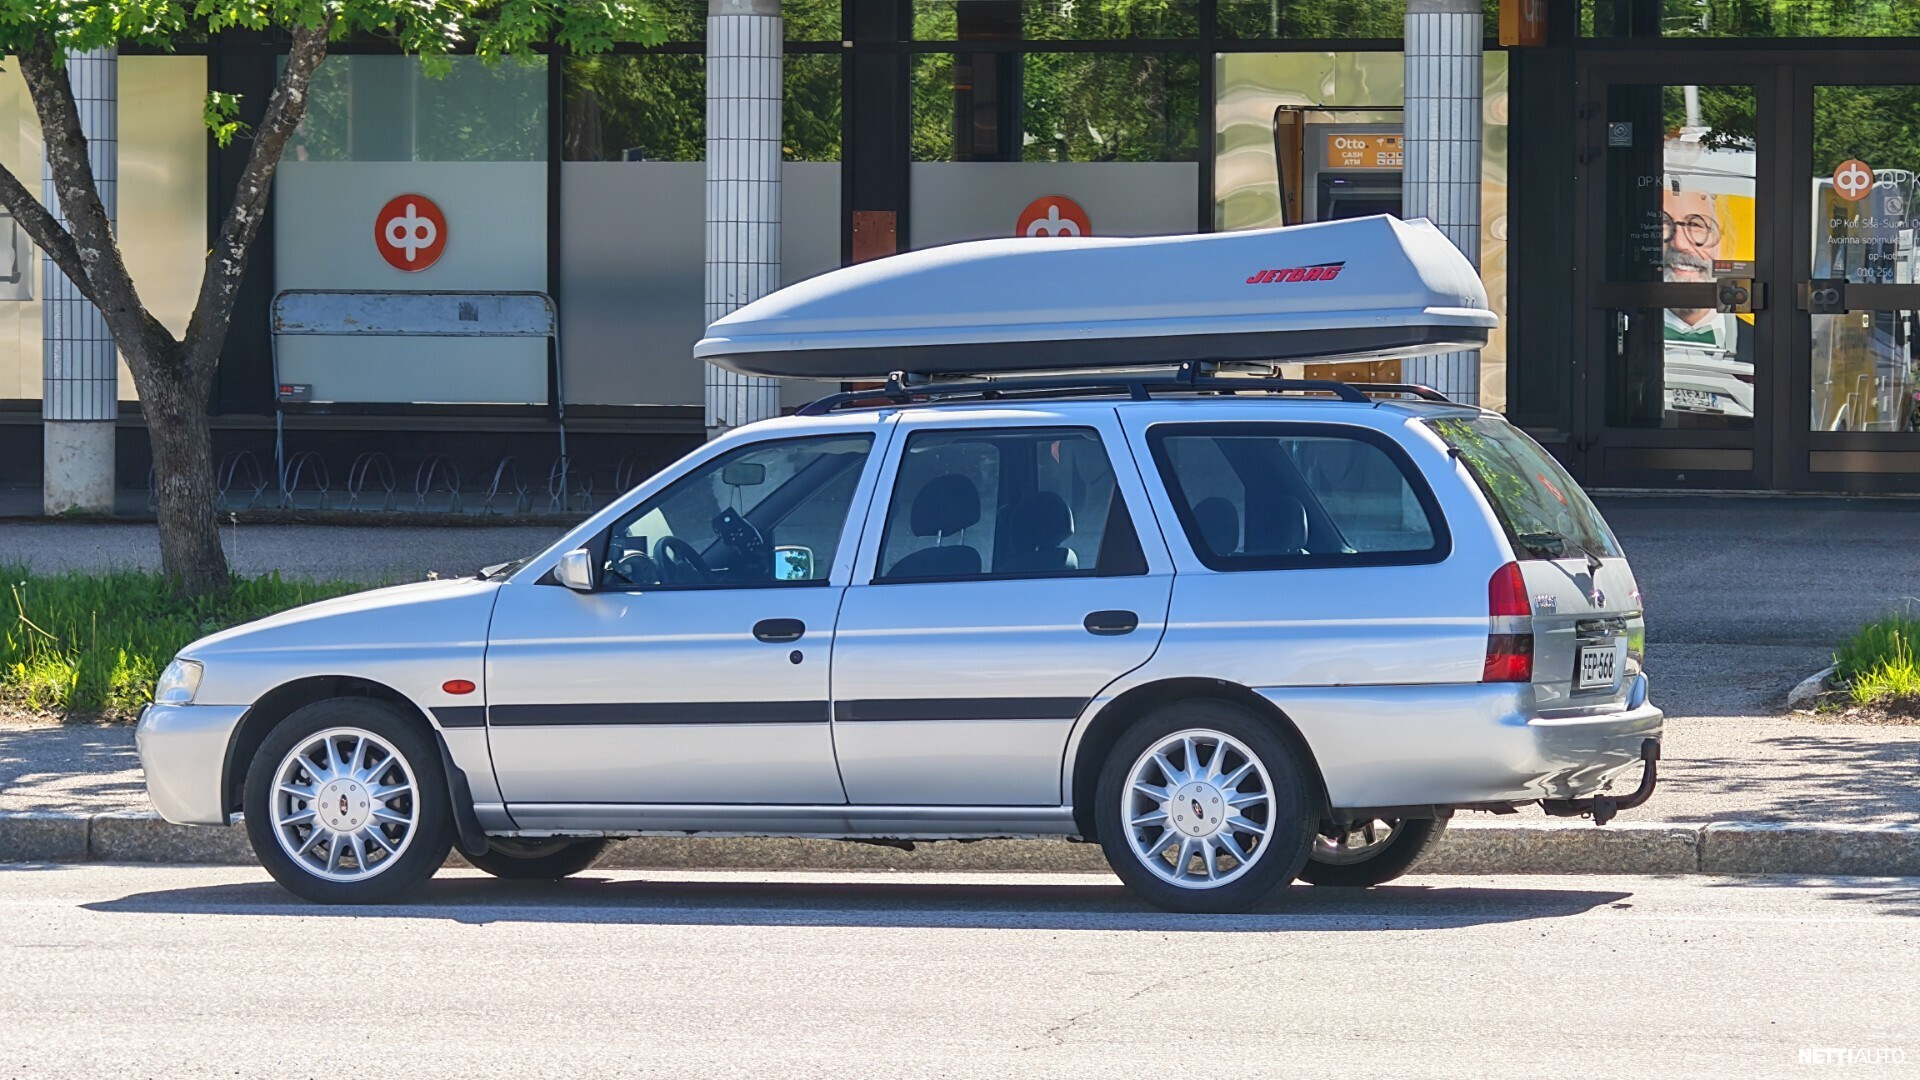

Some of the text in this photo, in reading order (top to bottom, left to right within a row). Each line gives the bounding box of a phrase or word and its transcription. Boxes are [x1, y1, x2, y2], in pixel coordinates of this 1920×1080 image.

[1637, 176, 1653, 187] OP
[1881, 171, 1907, 190] OP
[1830, 219, 1842, 229] OP
[1827, 236, 1860, 245] Avoinna
[1246, 267, 1343, 284] JETBAG
[1857, 267, 1894, 277] 010 256
[1582, 652, 1614, 681] FEP-568
